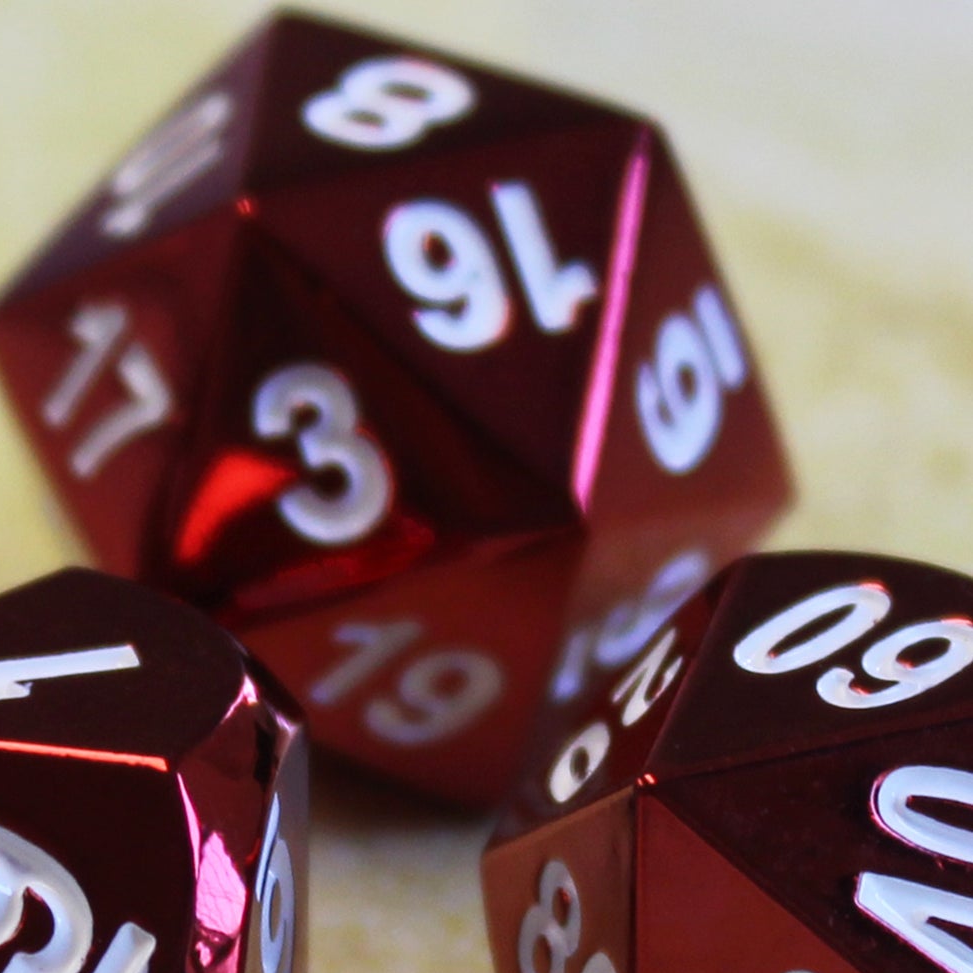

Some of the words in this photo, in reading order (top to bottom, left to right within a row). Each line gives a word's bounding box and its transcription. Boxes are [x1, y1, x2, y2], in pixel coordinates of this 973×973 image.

[302, 58, 476, 151] 8
[383, 180, 596, 350] 16
[42, 304, 172, 478] 17
[254, 364, 394, 545] 3
[309, 619, 503, 744] 19
[549, 627, 683, 803] 20
